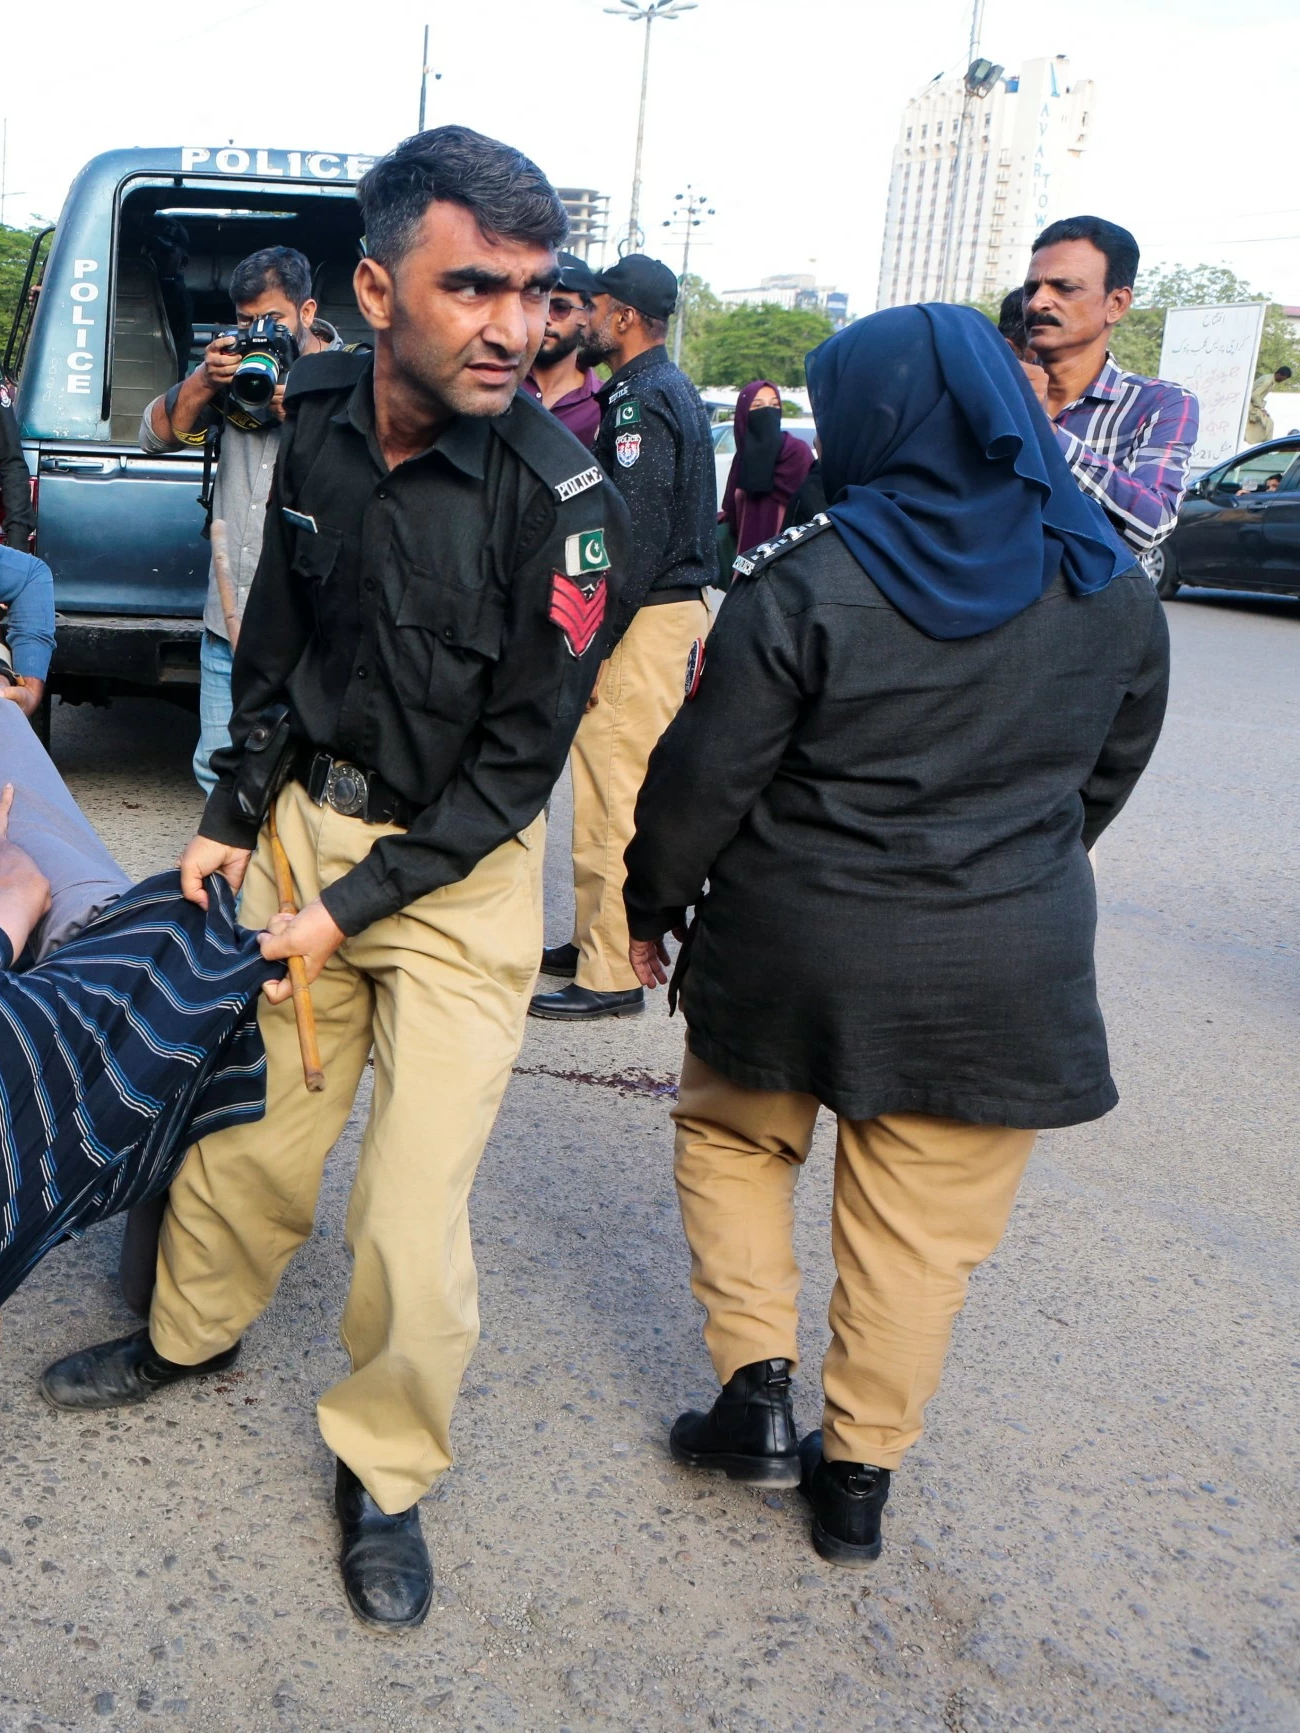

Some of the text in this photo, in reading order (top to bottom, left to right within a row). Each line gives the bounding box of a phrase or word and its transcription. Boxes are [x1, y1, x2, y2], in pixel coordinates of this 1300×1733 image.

[181, 147, 375, 180] POLICE
[66, 259, 99, 394] POLICE
[554, 466, 603, 502] POLICE
